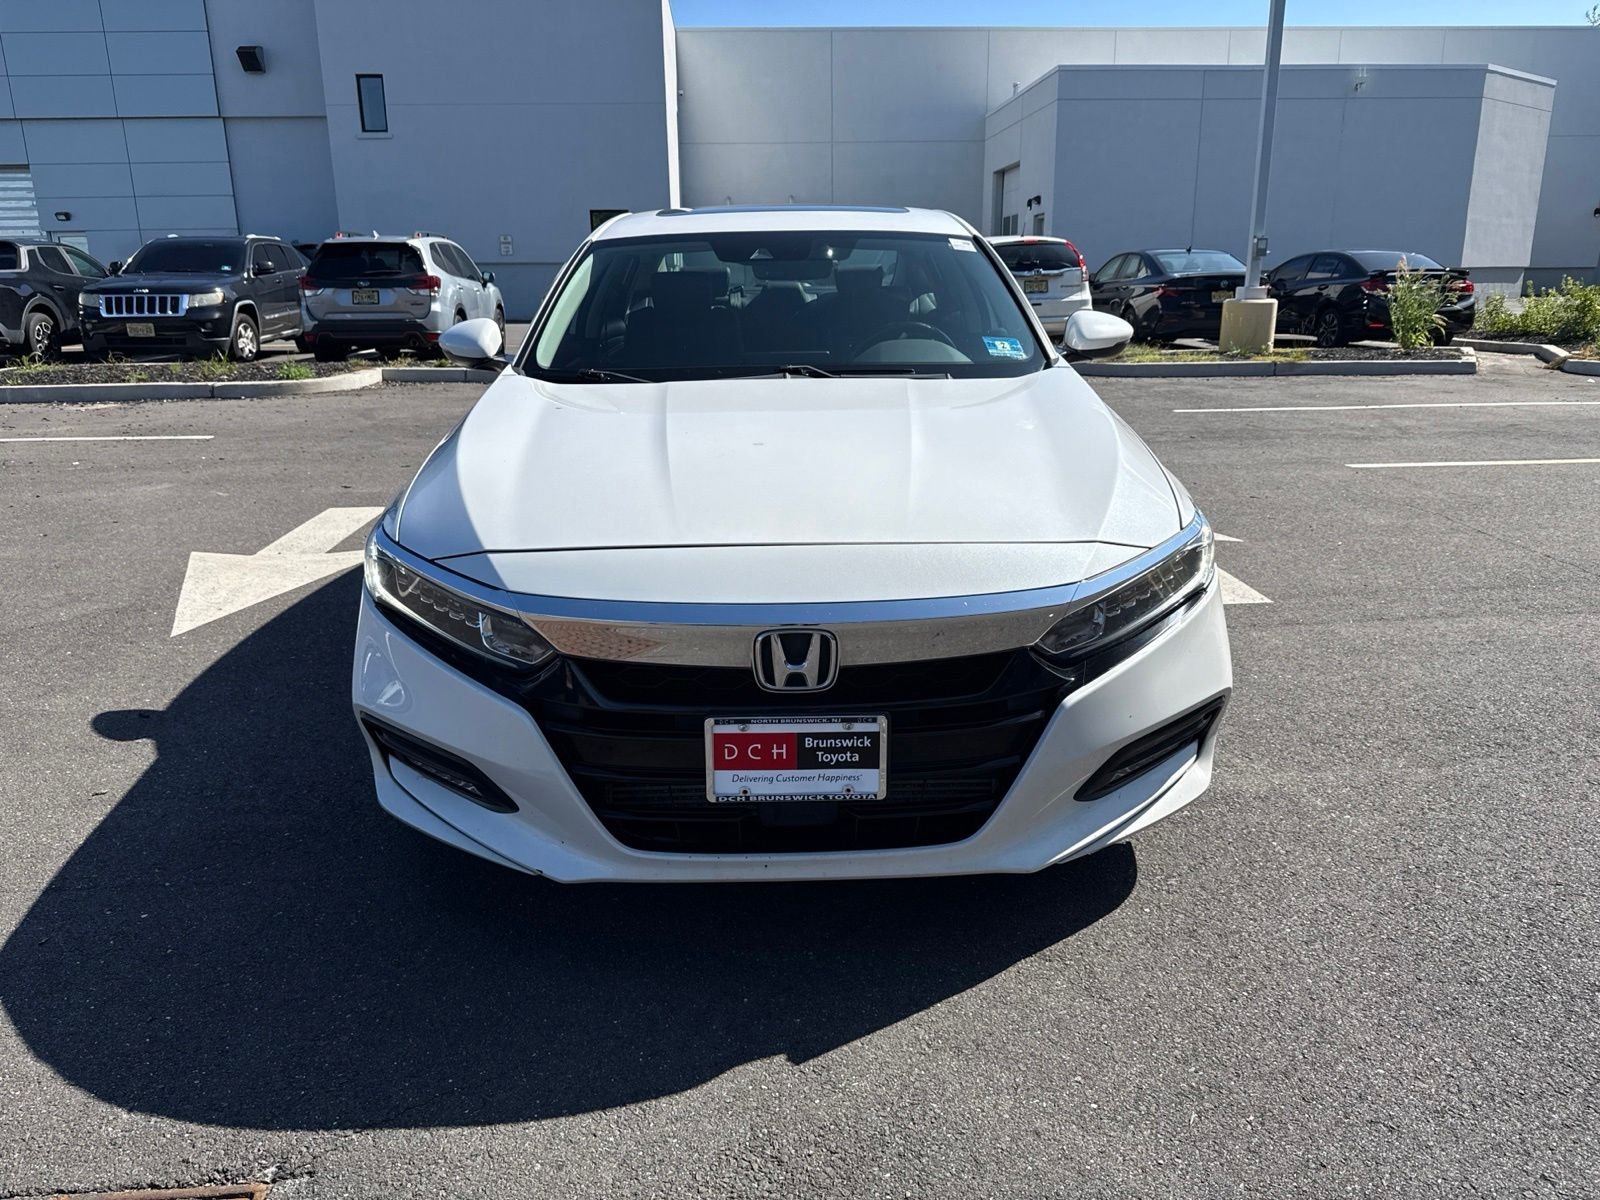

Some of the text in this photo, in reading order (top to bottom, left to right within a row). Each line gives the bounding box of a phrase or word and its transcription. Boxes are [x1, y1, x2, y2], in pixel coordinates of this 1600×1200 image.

[804, 736, 872, 748] Brunswick
[816, 751, 860, 765] Toyota
[731, 773, 774, 784] Delivering
[775, 773, 816, 783] Customer
